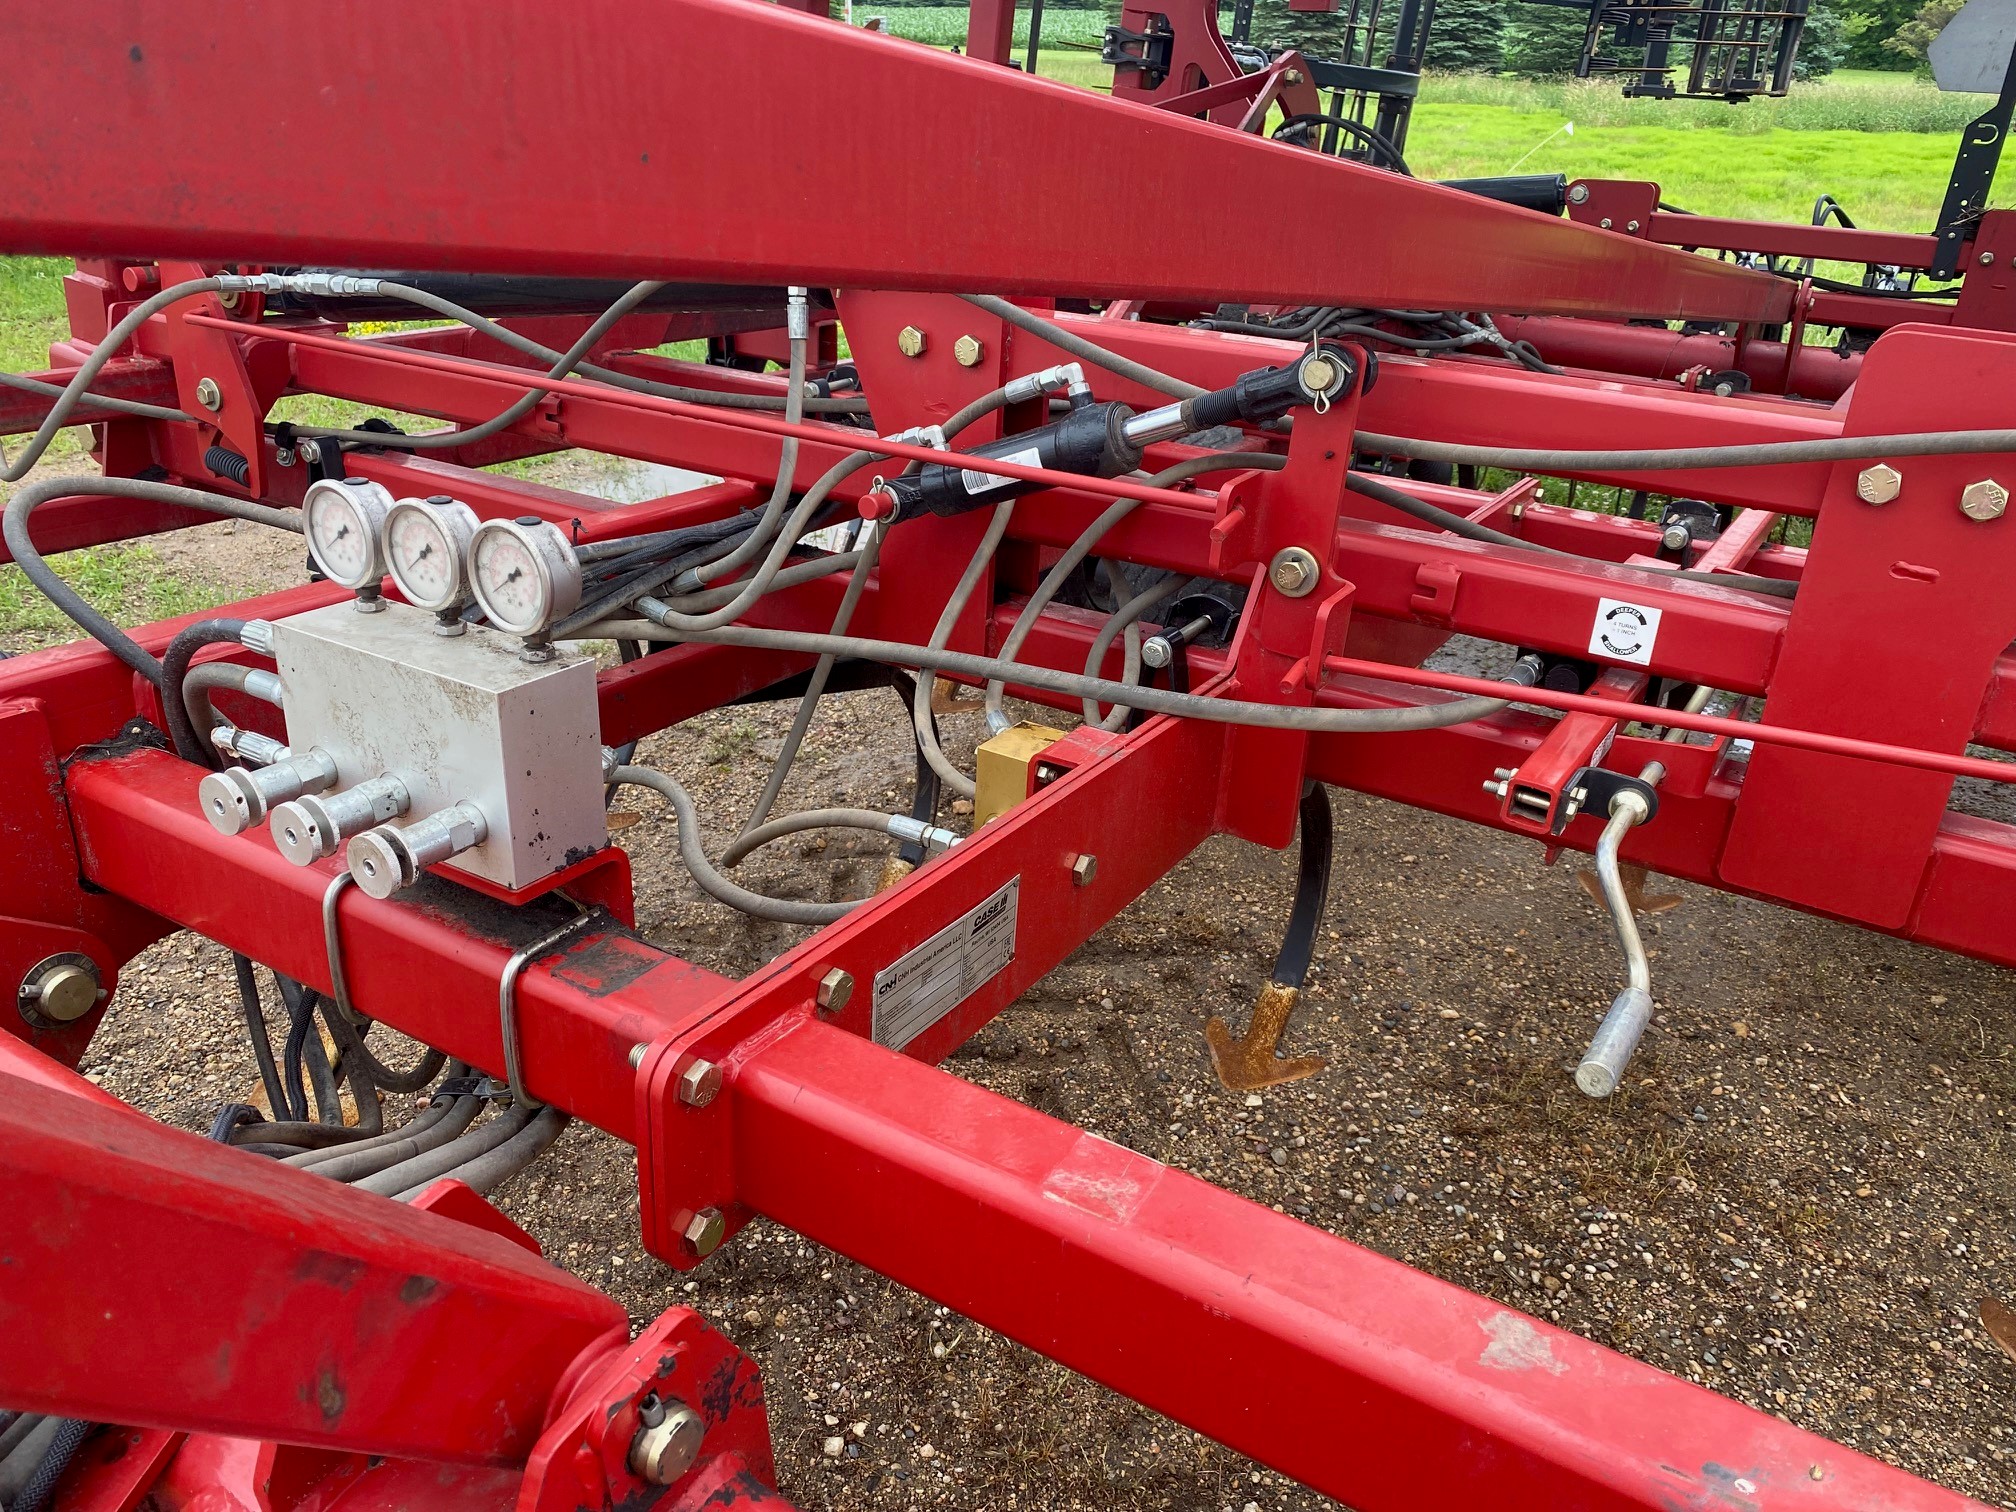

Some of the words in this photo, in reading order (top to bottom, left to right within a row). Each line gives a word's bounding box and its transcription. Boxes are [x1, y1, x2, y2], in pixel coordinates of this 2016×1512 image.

[1615, 607, 1641, 618] DEEPER
[1618, 622, 1638, 631] TURNS
[1603, 640, 1638, 655] SHALLOWER
[974, 900, 1000, 927] CASE
[987, 936, 997, 947] USA
[878, 973, 898, 995] CNH
[897, 968, 910, 983] CNH
[909, 953, 933, 974] Industrial
[932, 941, 952, 959] America
[952, 932, 962, 944] LLC
